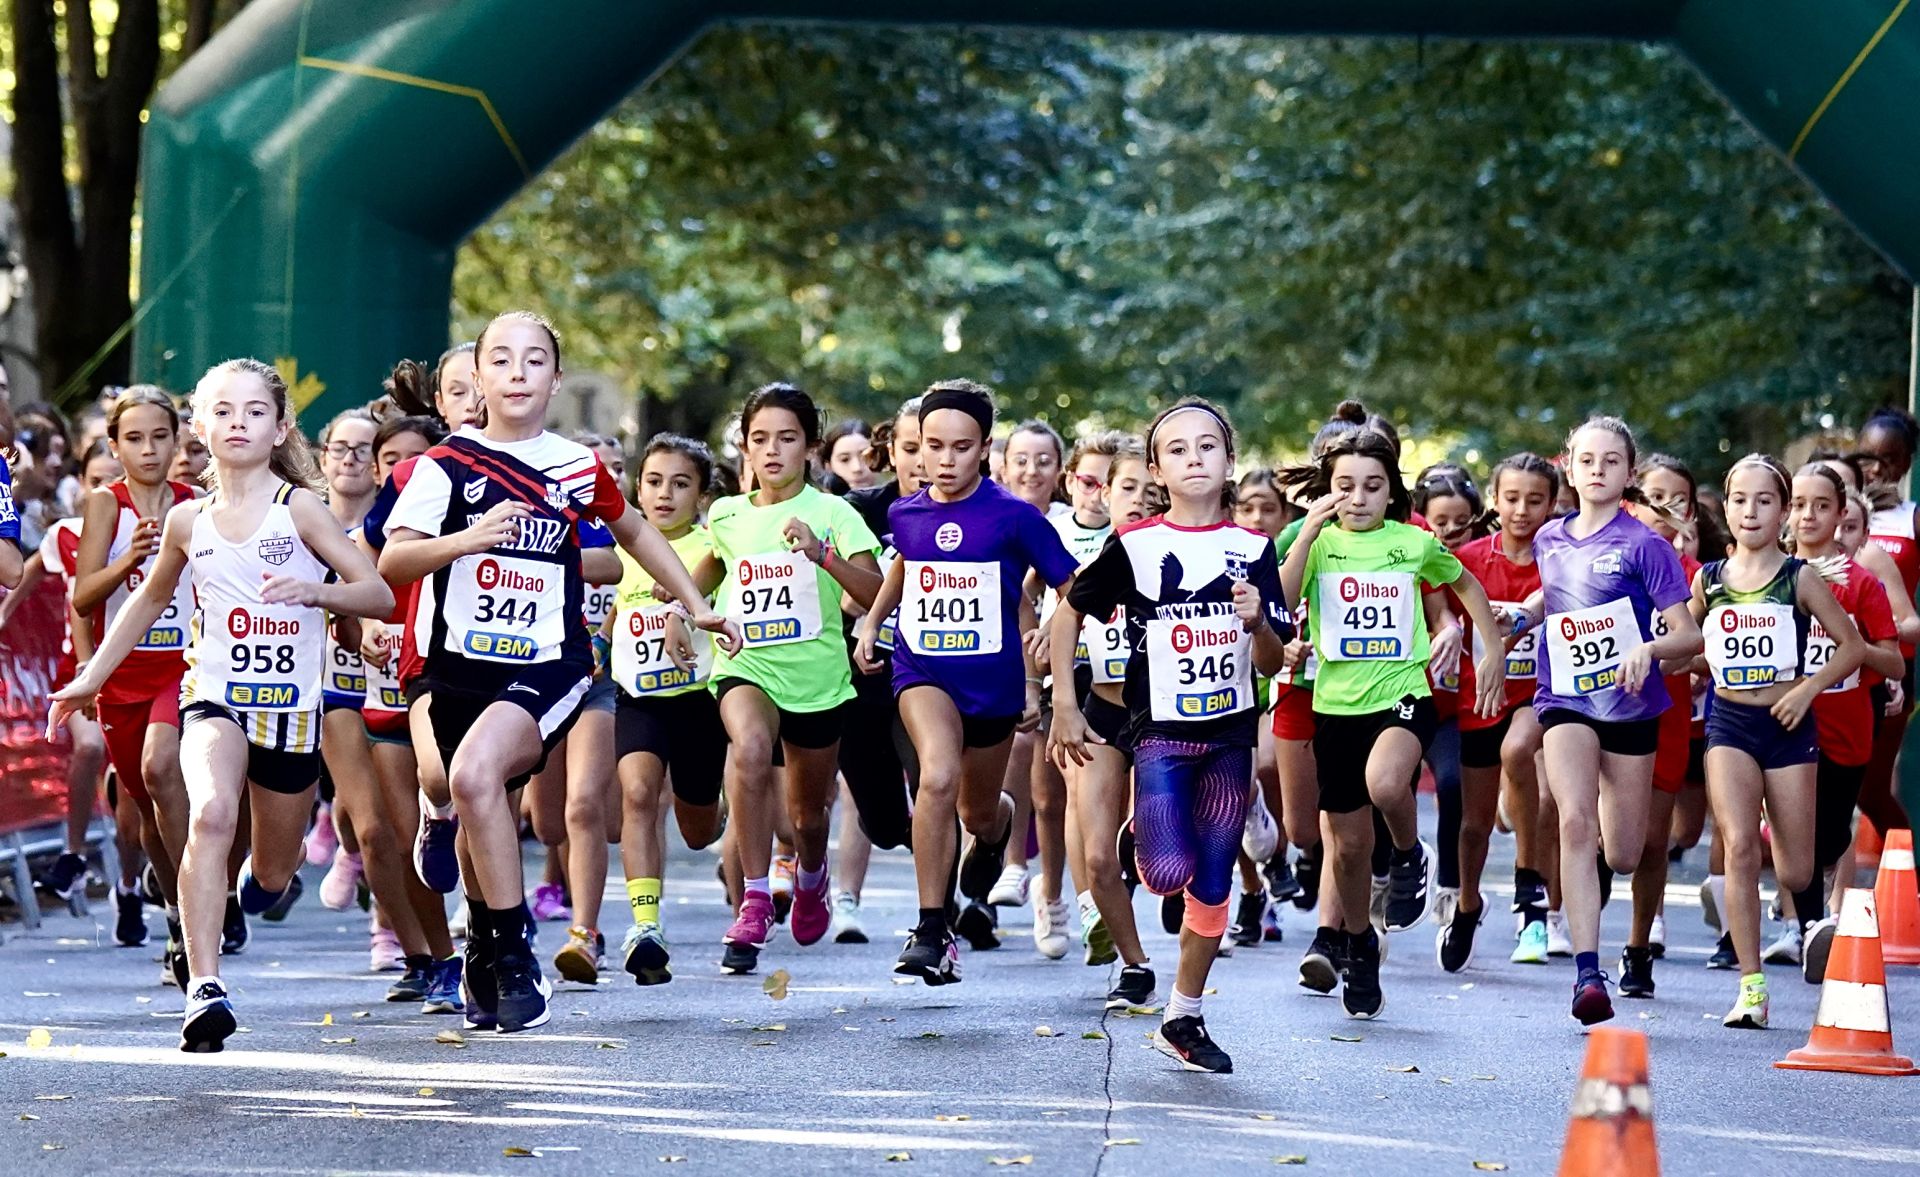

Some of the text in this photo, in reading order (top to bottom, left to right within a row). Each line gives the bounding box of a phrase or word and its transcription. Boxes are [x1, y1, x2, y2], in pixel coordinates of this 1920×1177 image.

[195, 548, 214, 559] KAIXO
[478, 560, 545, 592] Bilbao
[740, 561, 793, 584] Bilbao
[921, 567, 978, 591] Bilbao
[741, 586, 794, 614] 974
[1341, 578, 1399, 601] Bilbao
[474, 594, 538, 628] 344
[917, 597, 984, 623] 1401
[1343, 606, 1397, 630] 491
[1721, 610, 1776, 632] Bilbao
[229, 608, 300, 638] Bilbao
[631, 613, 666, 636] Bilb
[765, 621, 795, 638] BM
[1562, 616, 1615, 641] Bilbao
[148, 629, 178, 645] BM
[495, 637, 533, 657] BM
[943, 633, 975, 648] BM
[1172, 625, 1238, 652] Bilbao
[1367, 640, 1396, 655] BM
[1724, 635, 1774, 660] 960
[231, 643, 295, 674] 958
[635, 638, 666, 664] 97
[1569, 636, 1619, 668] 392
[661, 670, 689, 686] BM
[1178, 652, 1235, 685] 346
[1508, 661, 1533, 674] BM
[1746, 668, 1774, 683] BM
[257, 687, 293, 704] BM
[1206, 691, 1233, 713] BM
